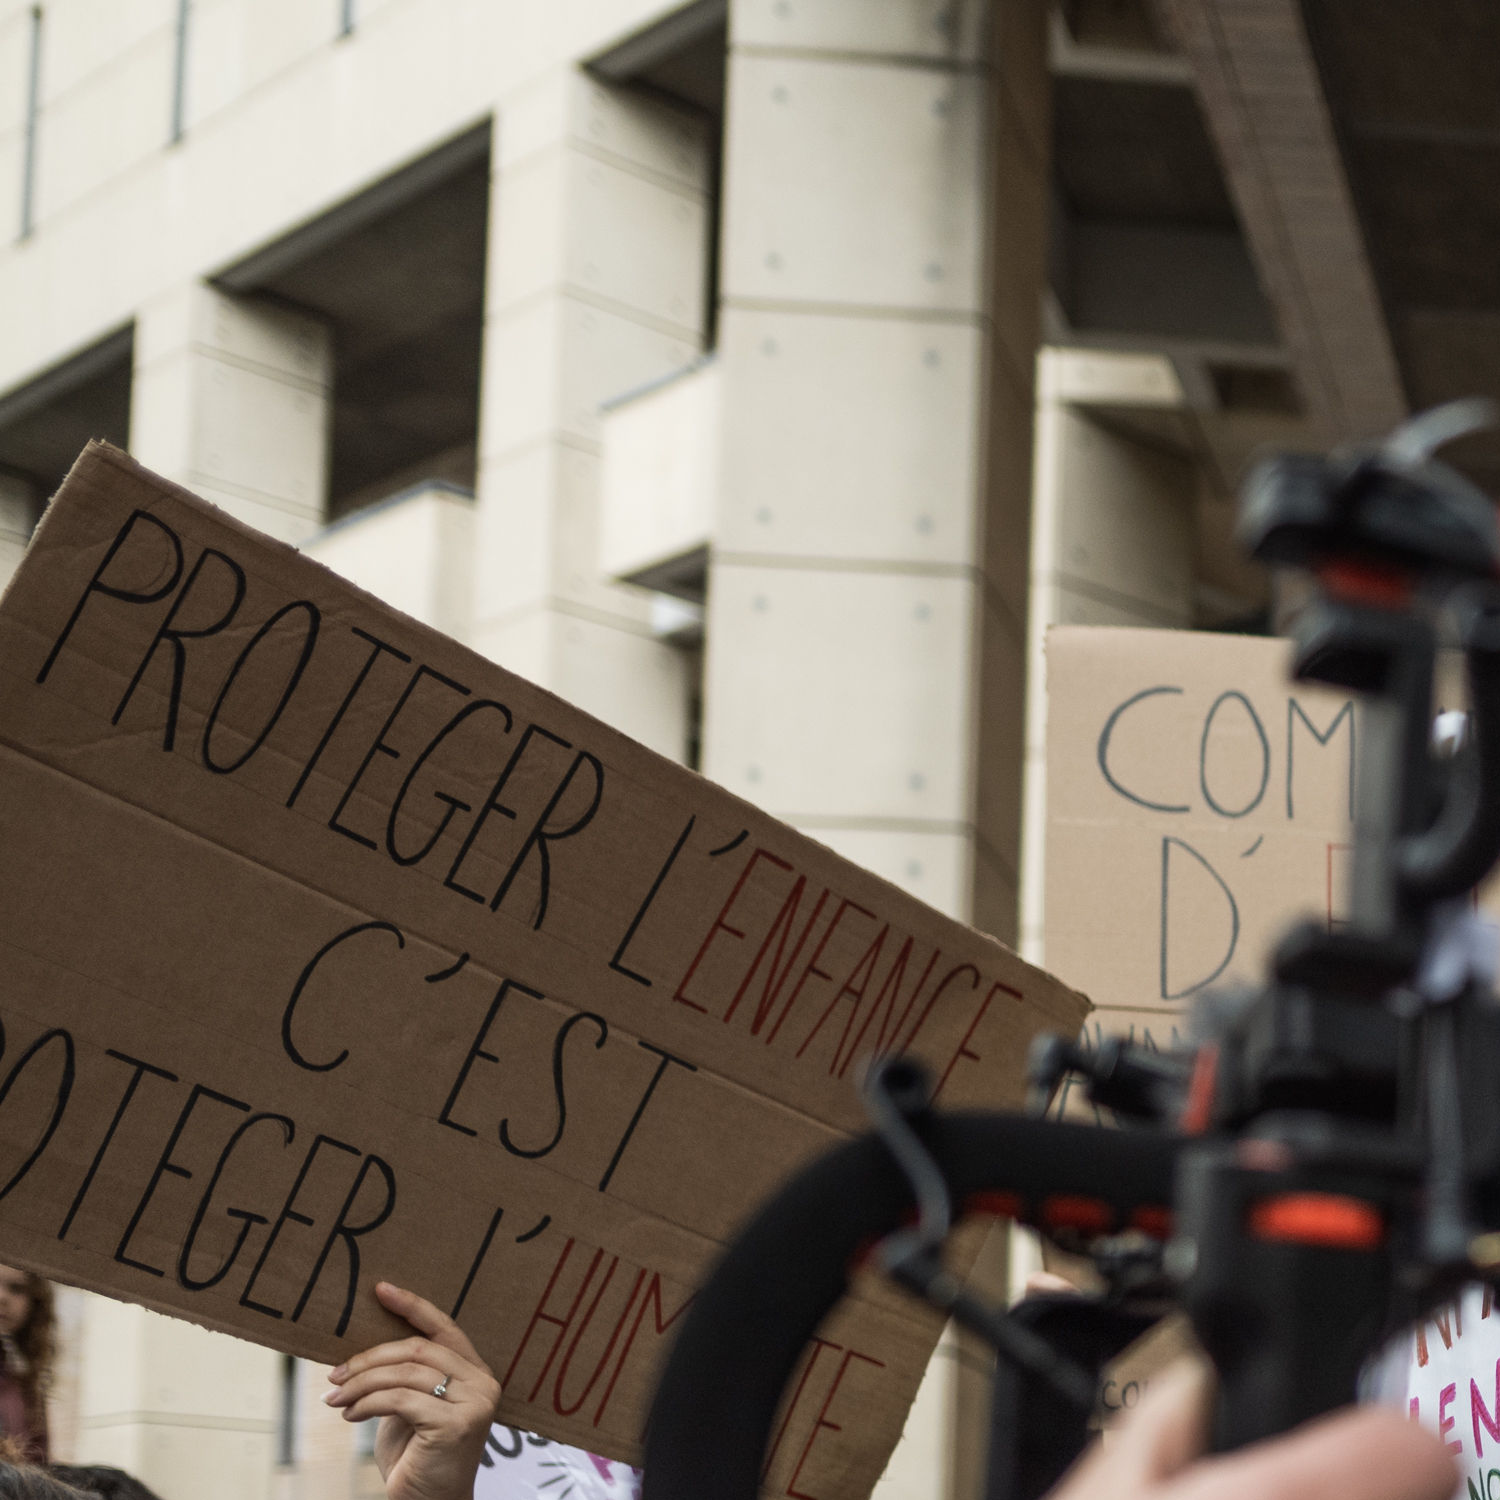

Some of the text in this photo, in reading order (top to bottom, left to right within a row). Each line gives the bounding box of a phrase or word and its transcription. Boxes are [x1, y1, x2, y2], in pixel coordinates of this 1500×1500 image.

[36, 509, 604, 931] PROTEGER
[0, 1012, 397, 1338] OTEGER
[282, 921, 698, 1194] C'EST
